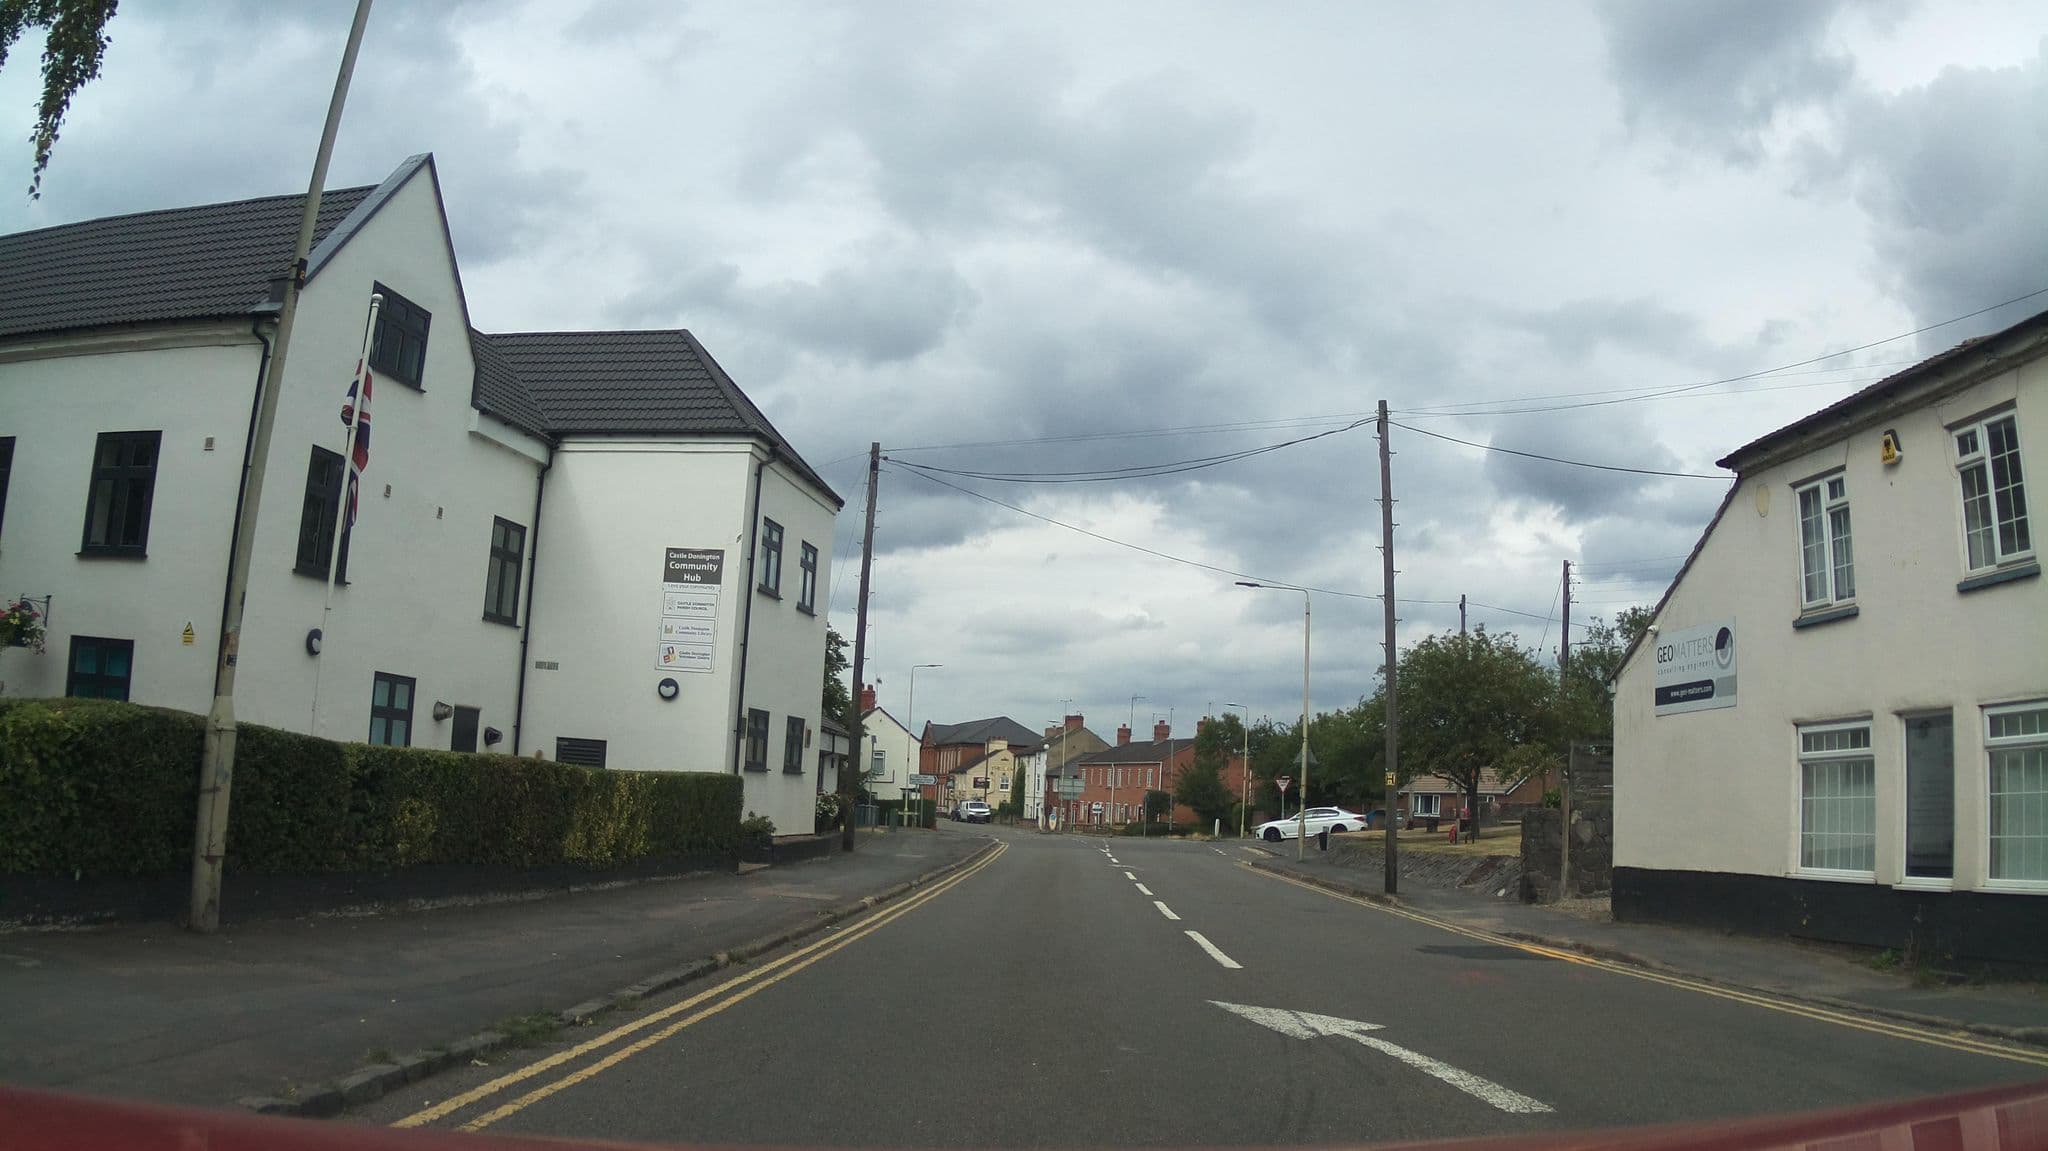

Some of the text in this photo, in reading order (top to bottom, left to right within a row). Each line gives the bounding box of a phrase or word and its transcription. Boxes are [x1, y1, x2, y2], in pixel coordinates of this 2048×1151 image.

[669, 551, 720, 561] Castle Donington
[669, 561, 719, 572] Community
[683, 573, 702, 582] Hub
